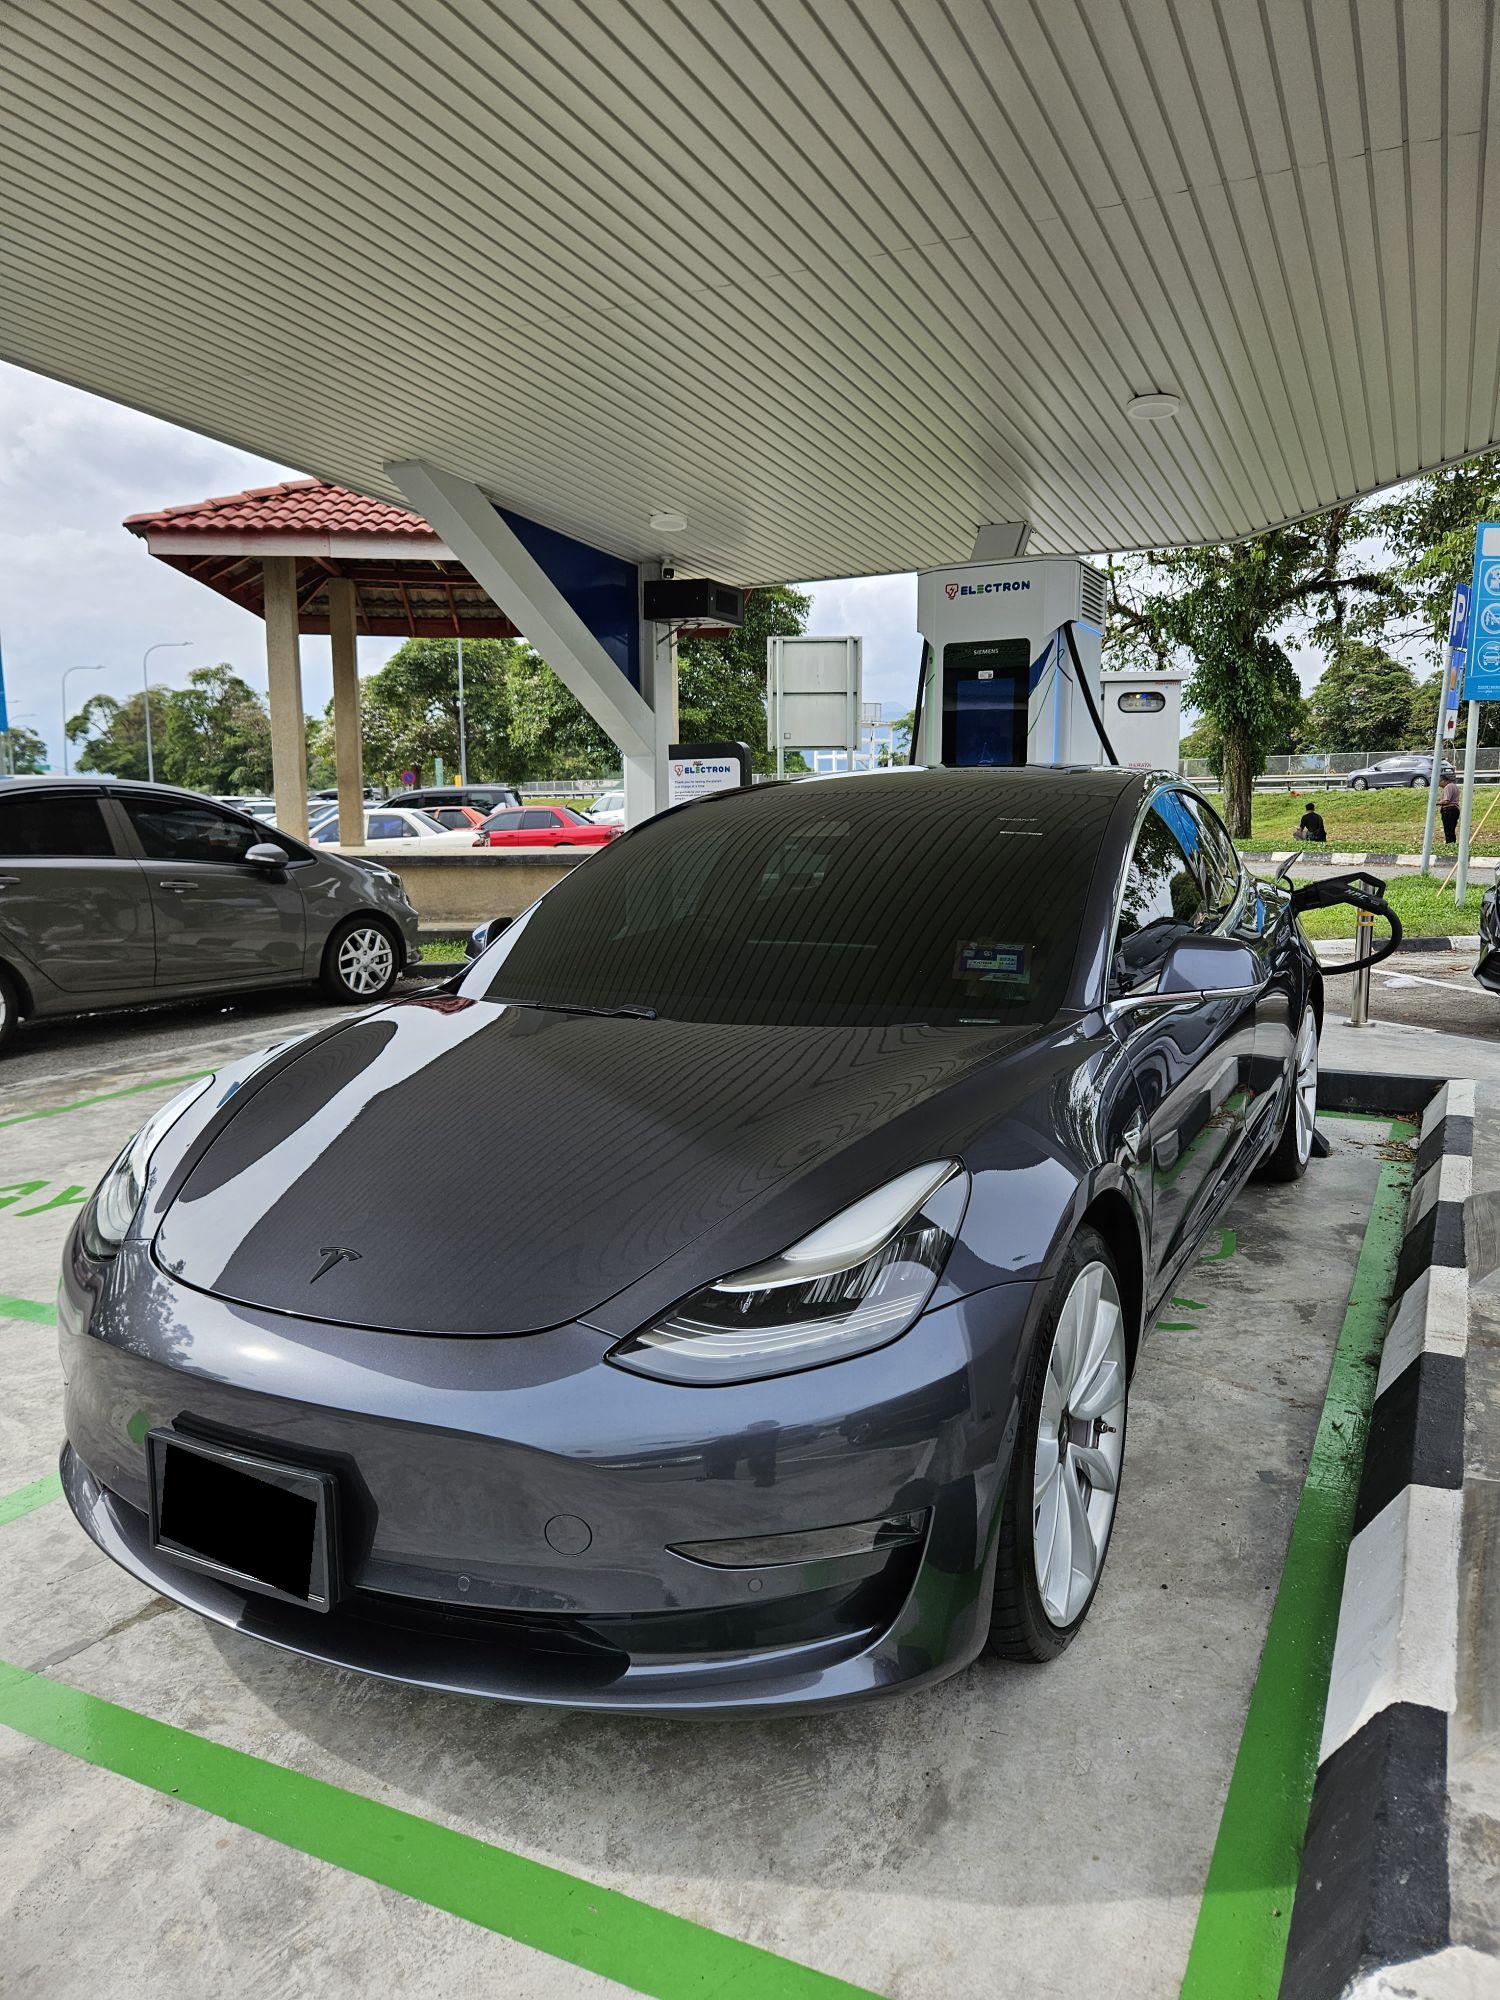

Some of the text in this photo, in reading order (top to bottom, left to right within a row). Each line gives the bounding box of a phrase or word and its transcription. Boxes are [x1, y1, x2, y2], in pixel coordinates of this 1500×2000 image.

[960, 580, 1030, 595] ELECTRON
[1453, 593, 1467, 636] P
[973, 648, 999, 656] SIEMENS
[684, 766, 730, 774] ELECTRON
